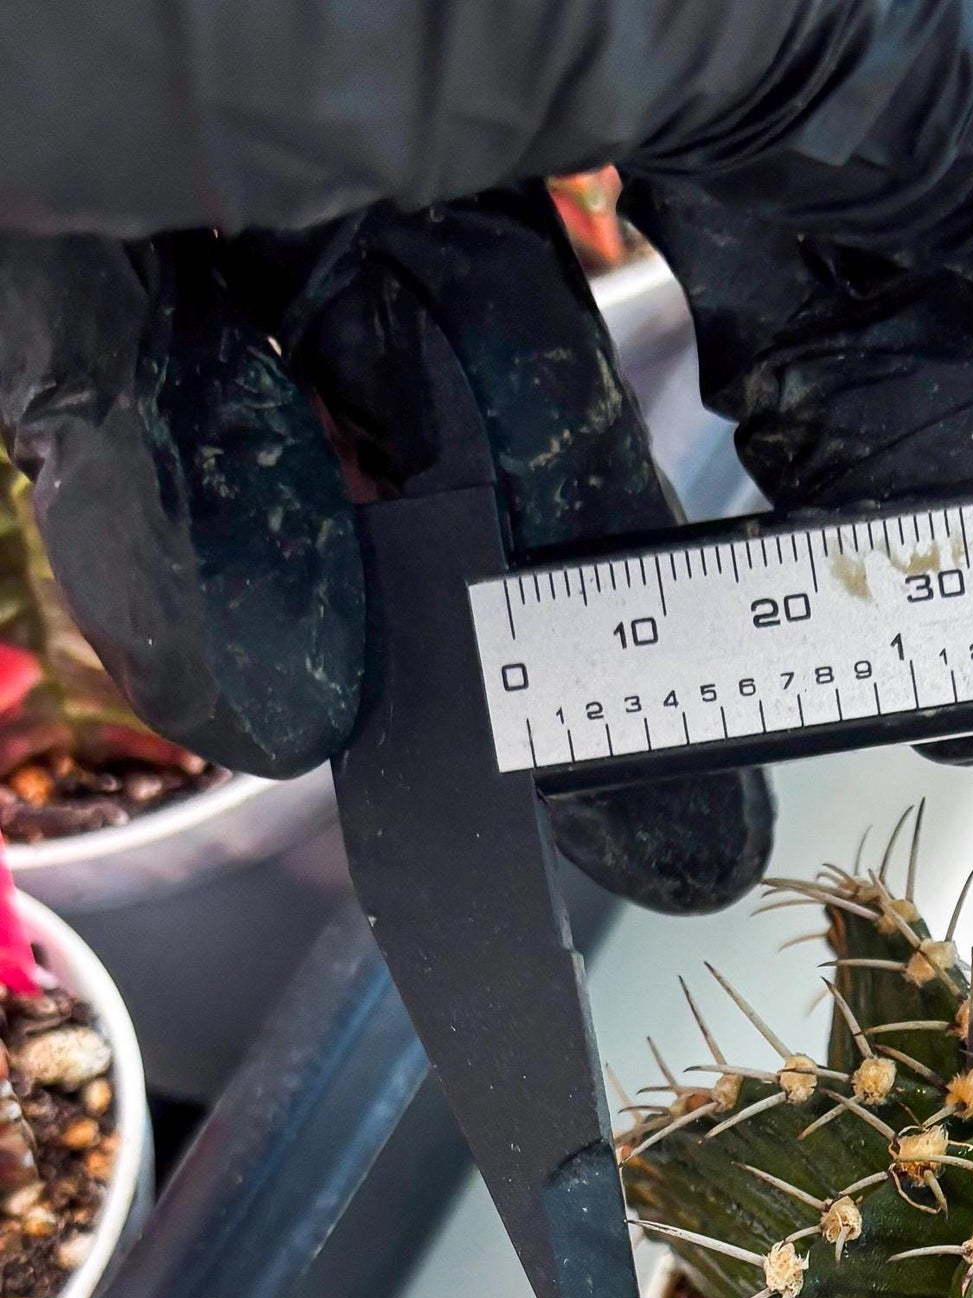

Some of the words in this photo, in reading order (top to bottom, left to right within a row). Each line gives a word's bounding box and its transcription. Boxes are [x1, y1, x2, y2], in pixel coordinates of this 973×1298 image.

[501, 663, 529, 691] 0
[614, 617, 658, 649] 10
[751, 593, 811, 628] 20
[905, 569, 965, 602] 30
[556, 707, 564, 724] 1
[586, 702, 604, 720] 2
[624, 696, 642, 713] 3
[663, 690, 678, 708] 4
[700, 684, 717, 702] 5
[739, 678, 756, 696] 6
[781, 672, 794, 689] 7
[815, 666, 834, 684] 8
[854, 660, 872, 679] 9
[891, 633, 904, 660] 1
[940, 648, 947, 665] 1
